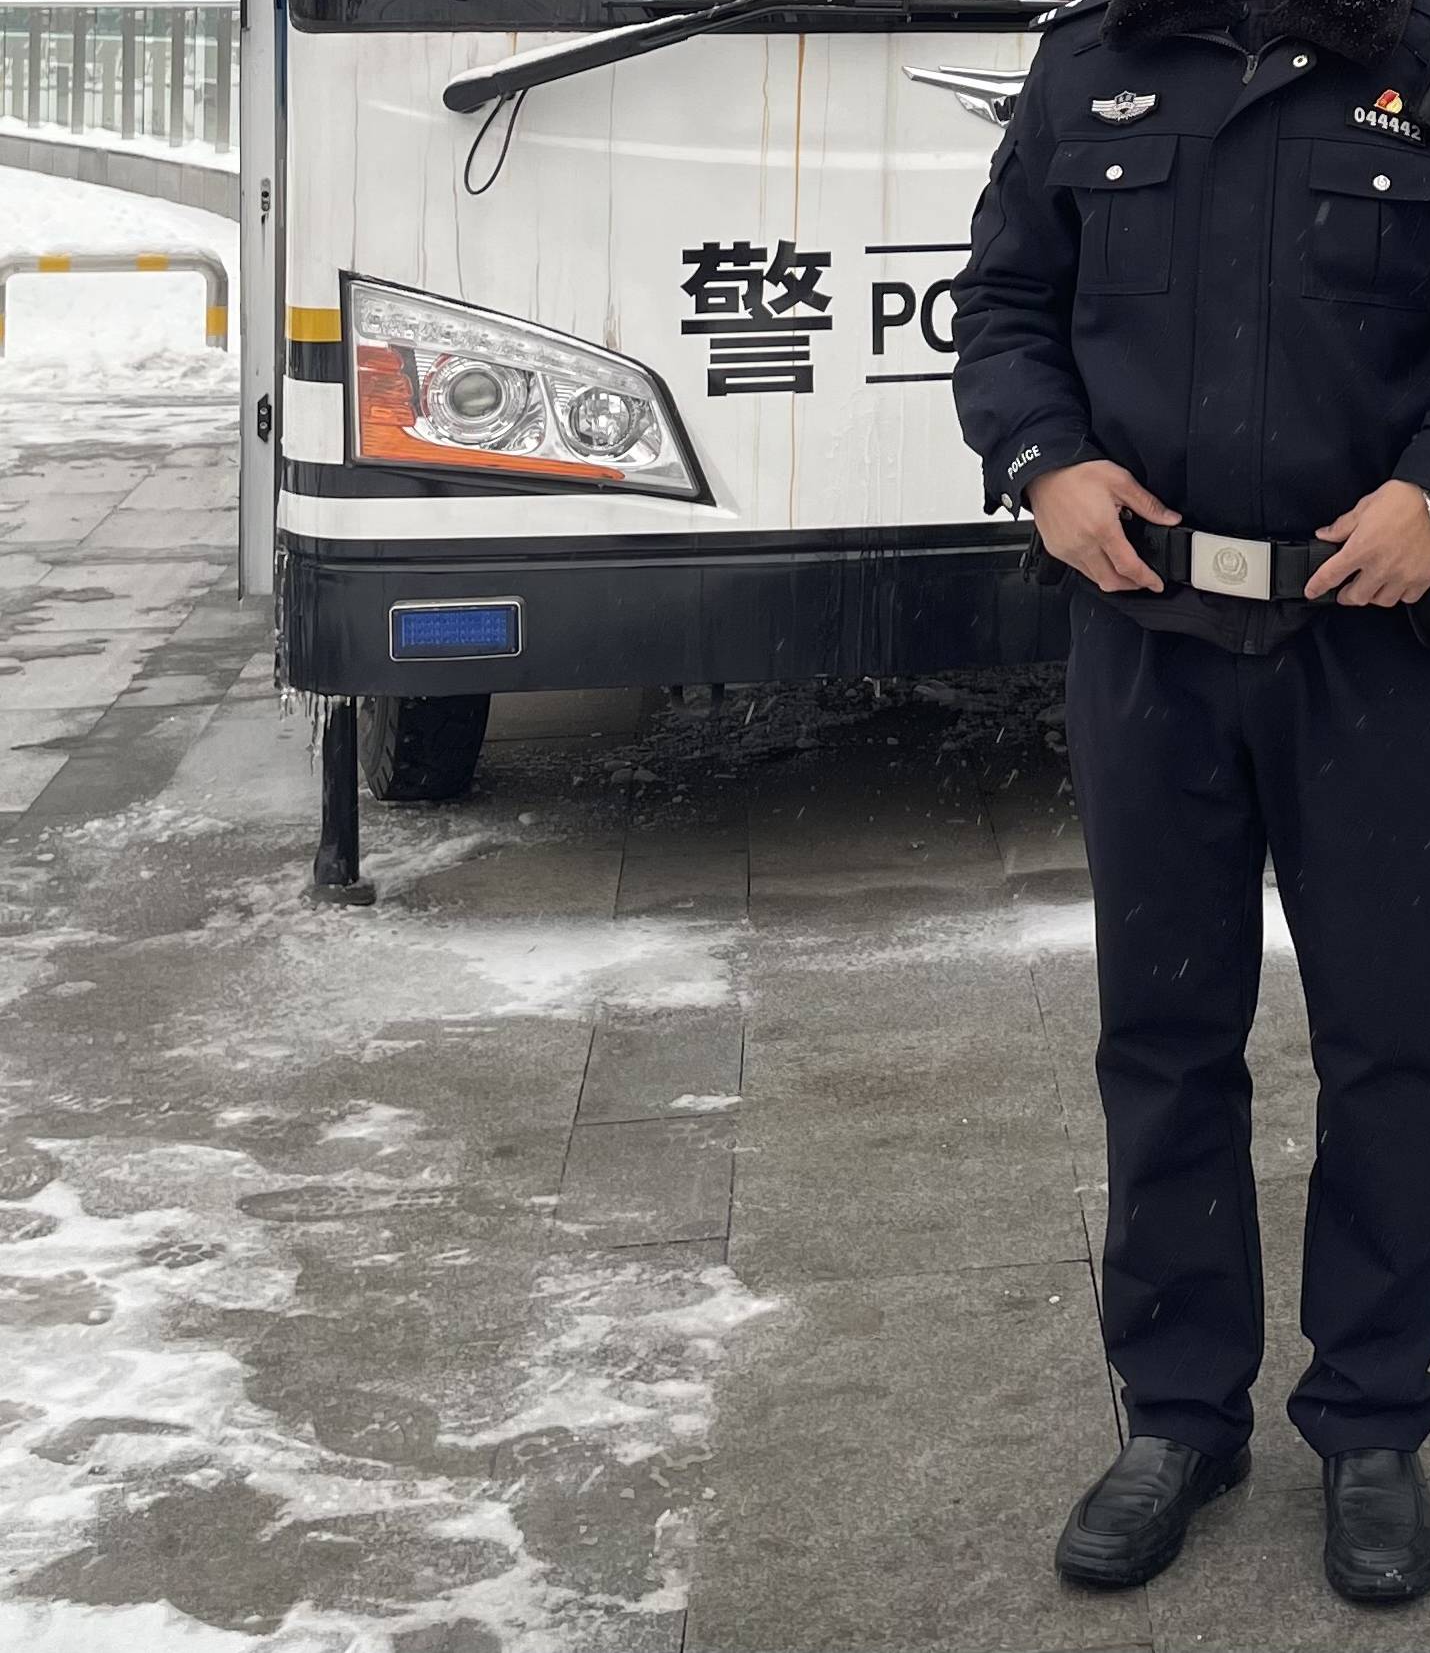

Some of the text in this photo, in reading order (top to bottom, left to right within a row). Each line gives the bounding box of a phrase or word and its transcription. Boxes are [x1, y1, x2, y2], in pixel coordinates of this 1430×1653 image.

[1354, 106, 1422, 141] 044442
[680, 239, 833, 397] 警
[1007, 444, 1042, 481] POLICE
